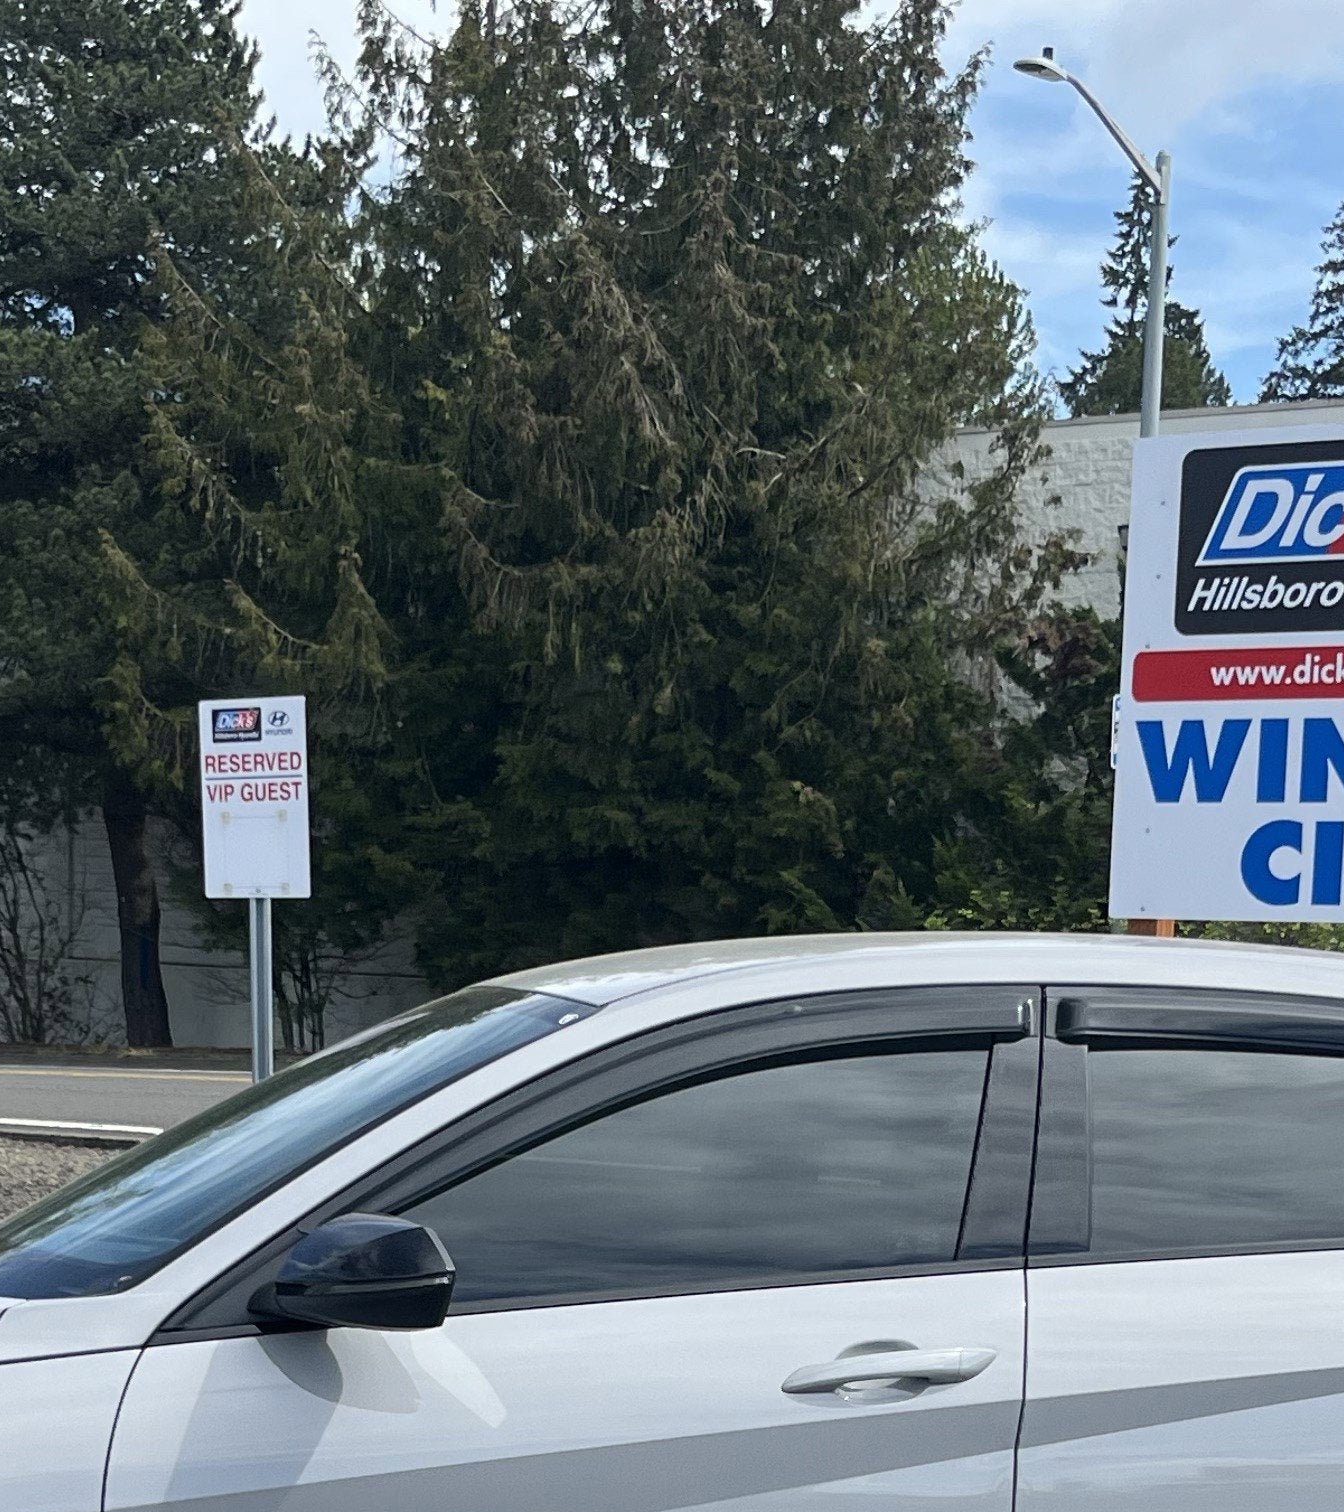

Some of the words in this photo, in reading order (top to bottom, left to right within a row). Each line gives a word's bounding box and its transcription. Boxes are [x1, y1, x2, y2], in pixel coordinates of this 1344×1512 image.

[1187, 575, 1344, 612] Hillsboro
[205, 751, 302, 774] RESERVED
[207, 783, 234, 803] VIP
[240, 781, 302, 801] GUEST
